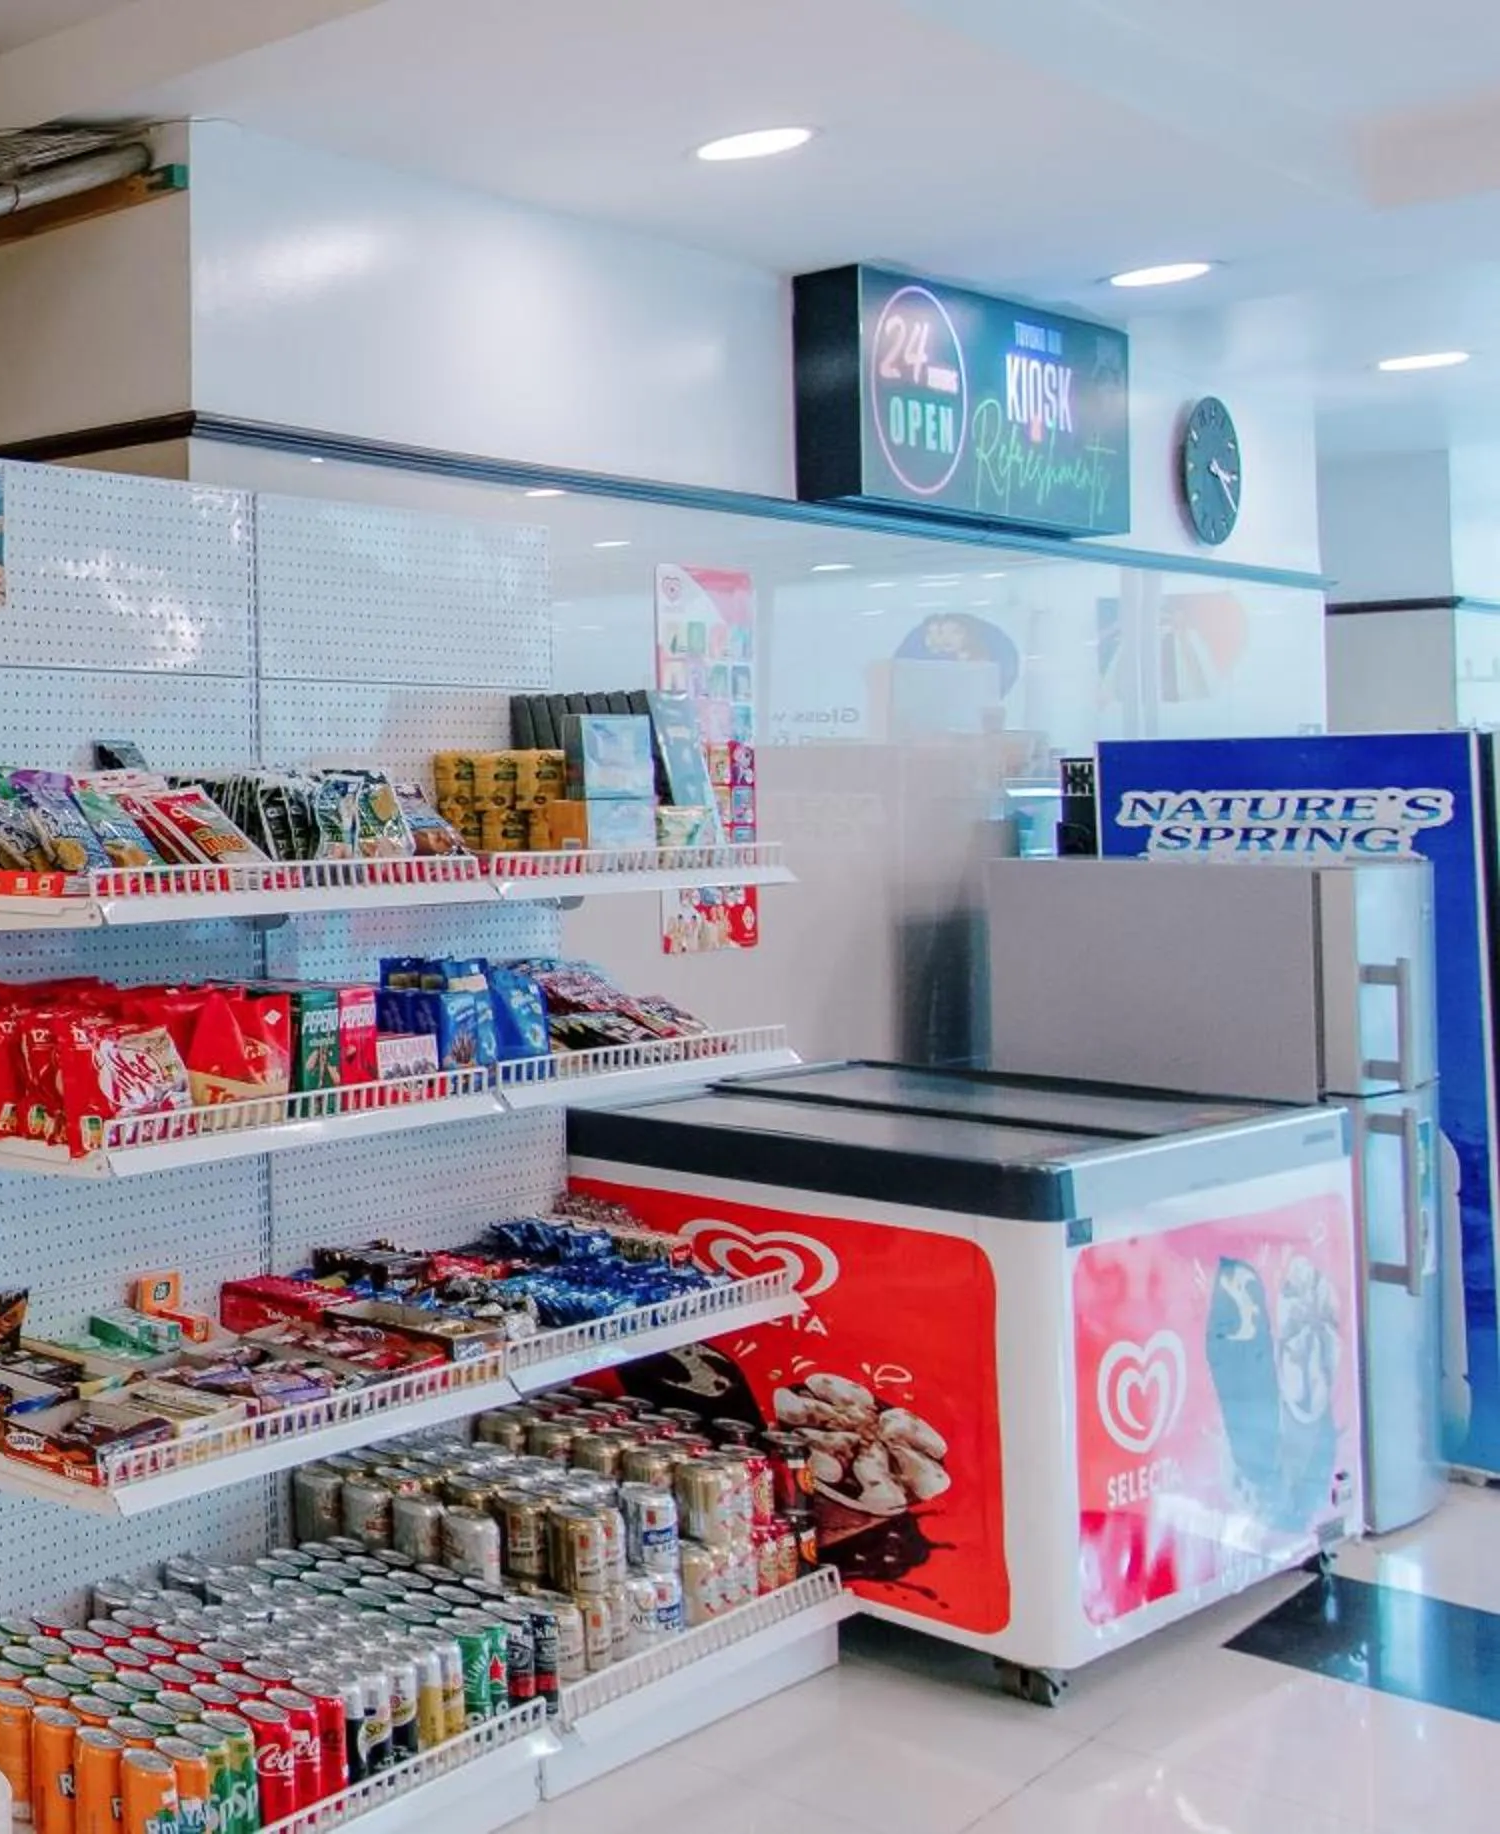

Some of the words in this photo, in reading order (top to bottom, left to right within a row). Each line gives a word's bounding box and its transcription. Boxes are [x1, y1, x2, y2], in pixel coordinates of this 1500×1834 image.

[880, 315, 928, 384] 24
[1005, 353, 1073, 434] KIOSK
[889, 395, 955, 454] OPEN
[1126, 794, 1443, 822] NATURE'S
[1155, 825, 1401, 853] SPRING
